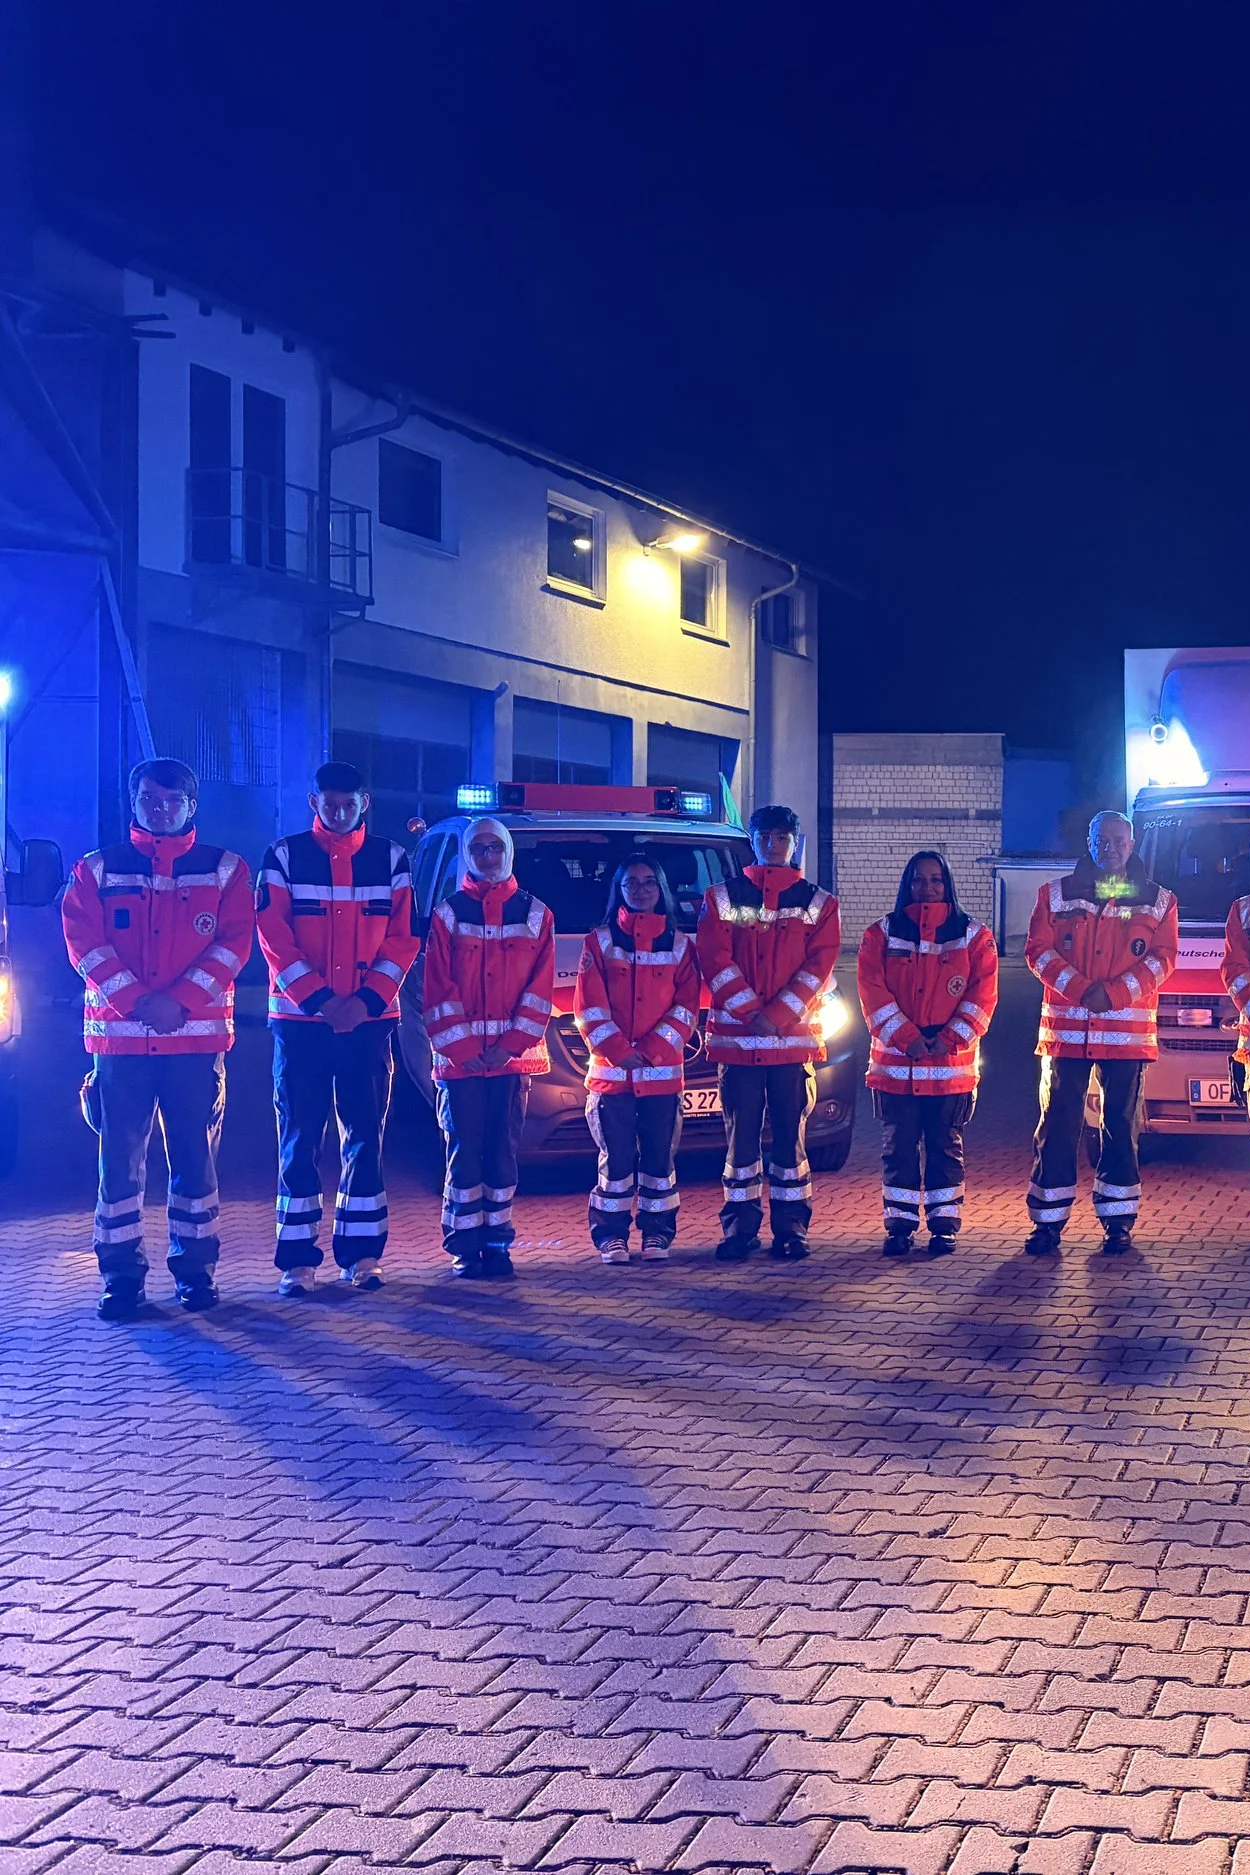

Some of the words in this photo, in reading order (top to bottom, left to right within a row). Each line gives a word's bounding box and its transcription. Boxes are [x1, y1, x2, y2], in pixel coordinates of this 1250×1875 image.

[1143, 819, 1182, 830] 90-64-1
[1208, 1083, 1230, 1100] OF
[683, 1092, 693, 1110] S
